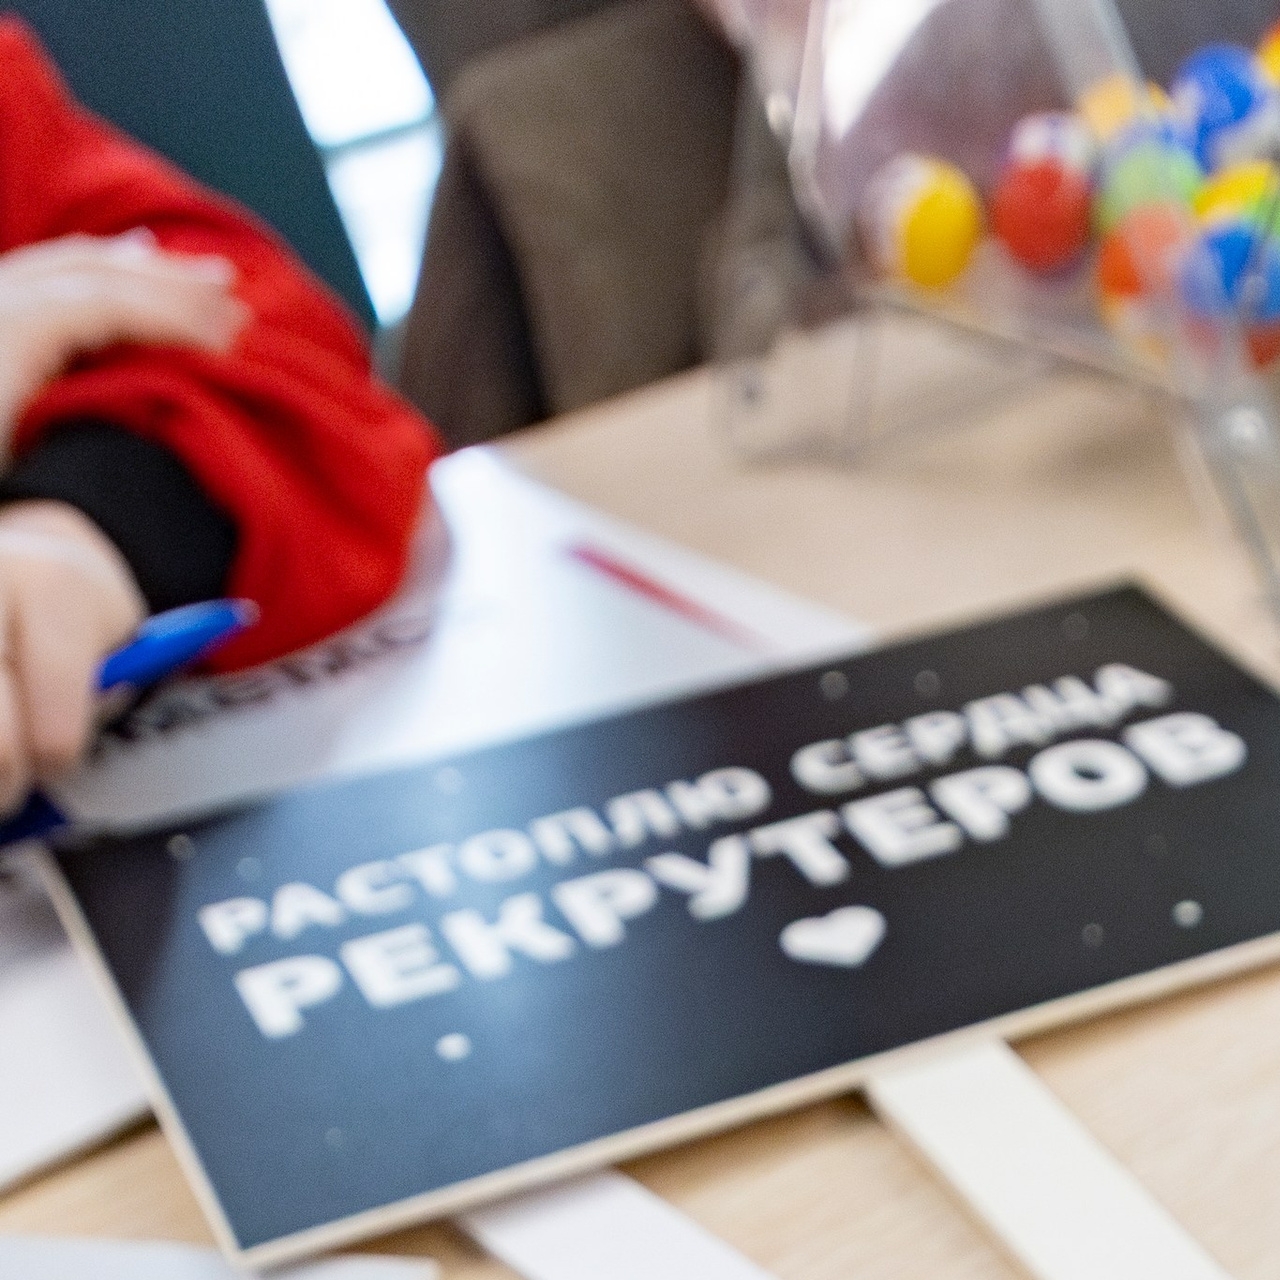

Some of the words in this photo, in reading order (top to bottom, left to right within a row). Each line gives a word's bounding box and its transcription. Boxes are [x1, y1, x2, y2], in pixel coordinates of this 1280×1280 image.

[200, 766, 772, 955] РАСТОПЛЮ
[790, 663, 1174, 795] СЕРДЦА
[233, 710, 1248, 1039] РЕКРУТЕРОВ
